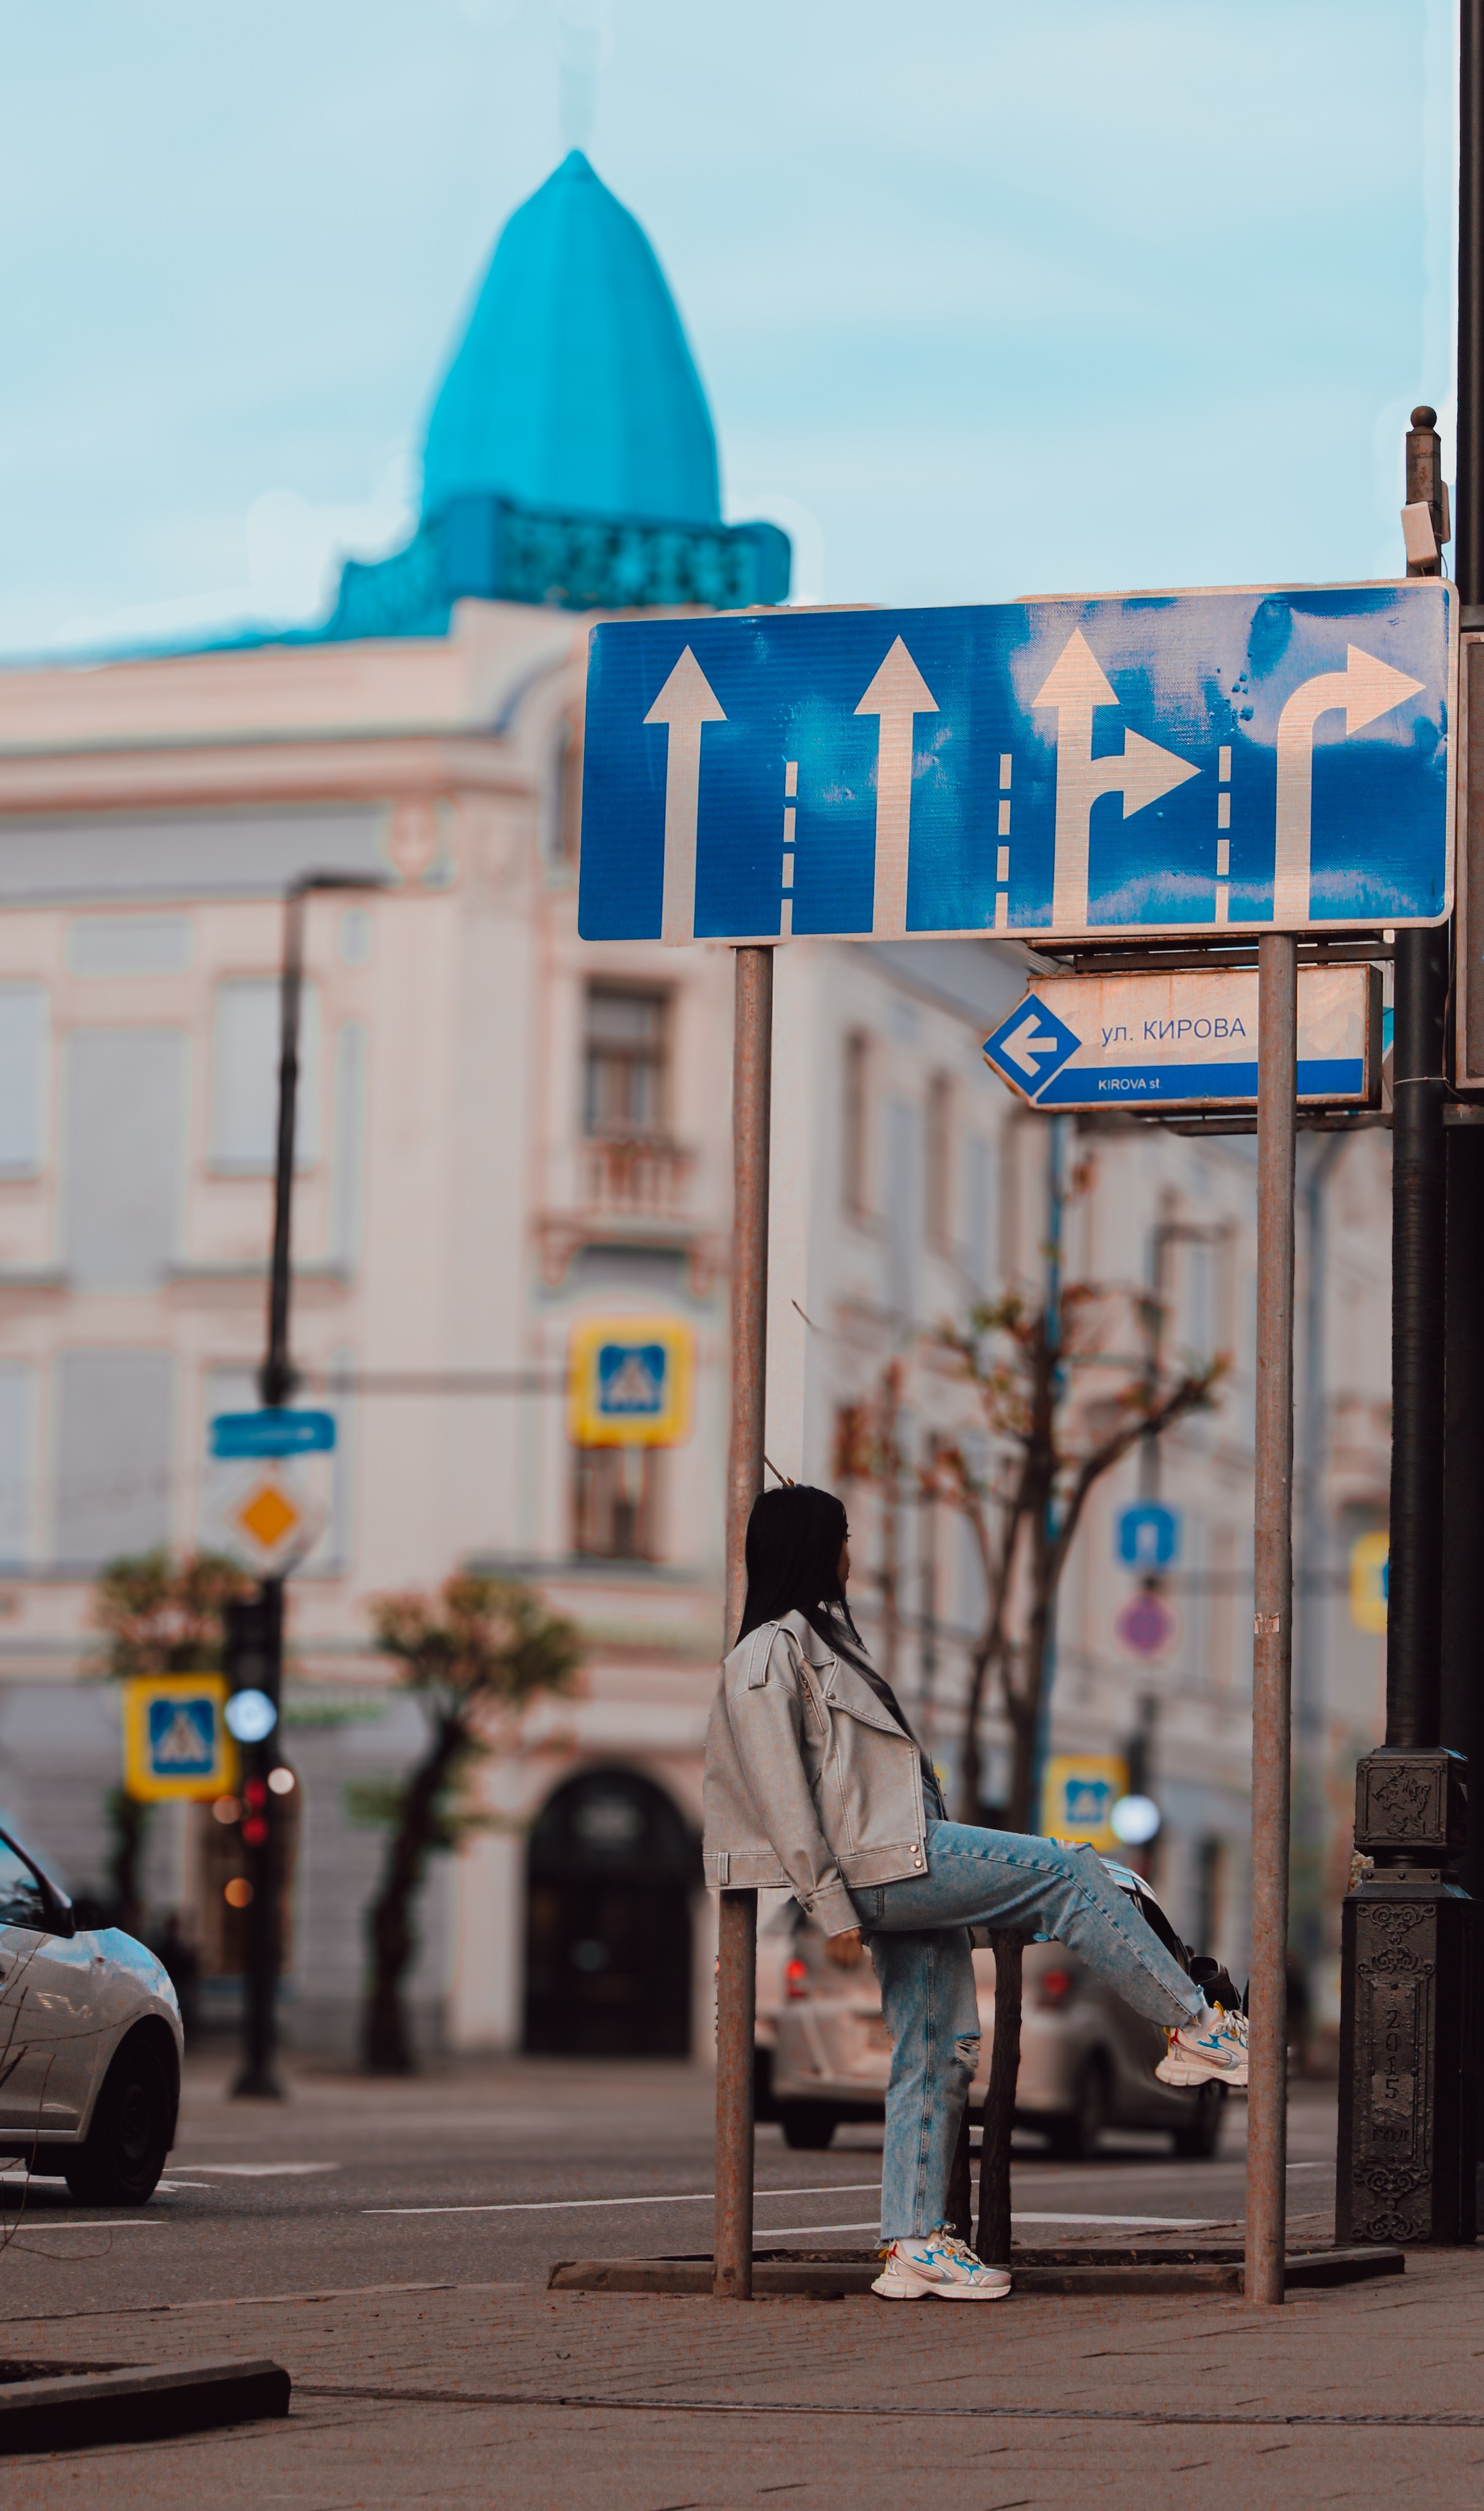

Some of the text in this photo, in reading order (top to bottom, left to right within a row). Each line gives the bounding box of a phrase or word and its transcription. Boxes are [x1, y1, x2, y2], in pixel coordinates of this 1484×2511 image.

[1101, 1018, 1246, 1047] ул. КИРОВА
[1098, 1078, 1147, 1090] KIROVA
[1385, 2009, 1401, 2099] 2015
